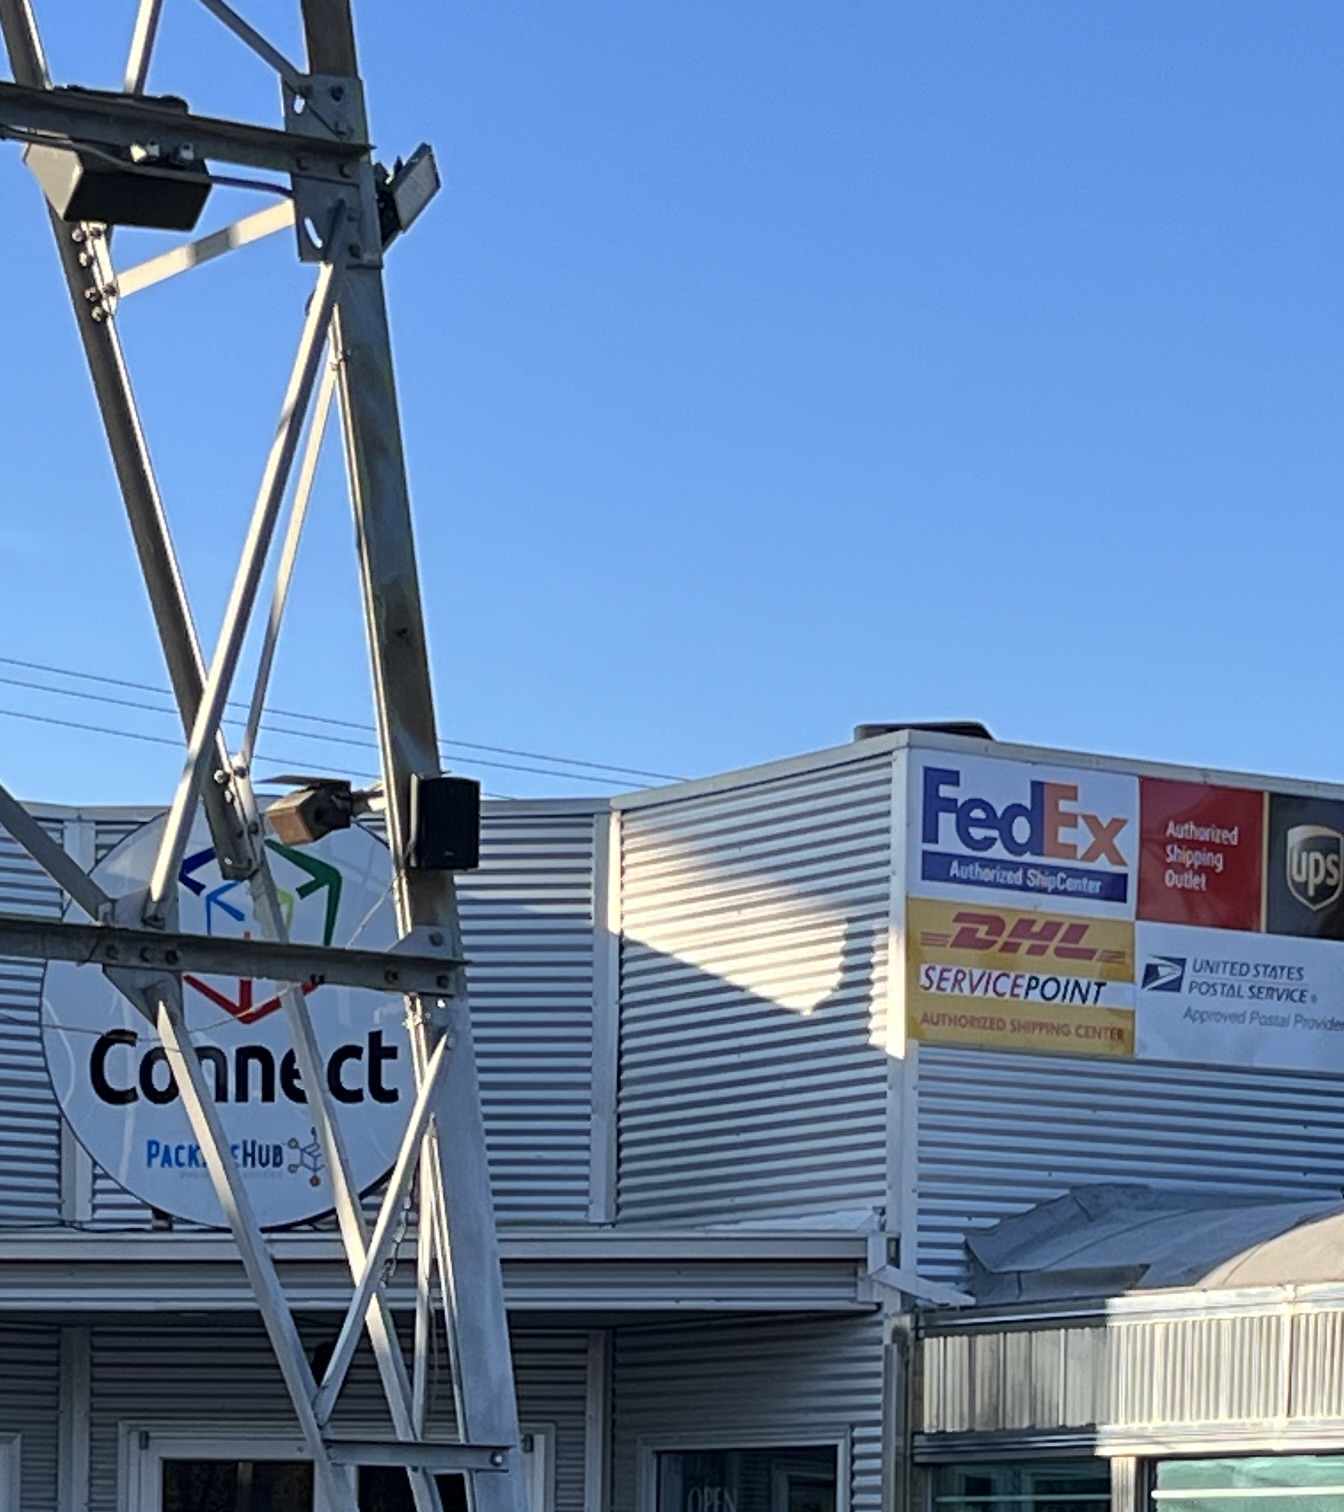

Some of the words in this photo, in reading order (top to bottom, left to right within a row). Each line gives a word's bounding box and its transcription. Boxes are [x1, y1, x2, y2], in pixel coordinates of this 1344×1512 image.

[922, 766, 1129, 867] FedEx
[1166, 821, 1238, 845] Authorized
[1166, 844, 1224, 873] Shipping
[1291, 849, 1340, 897] ups
[950, 860, 1022, 886] Authorized
[1027, 868, 1102, 893] ShipCenter
[1165, 869, 1207, 892] Outlet
[950, 911, 1098, 961] DHL
[1193, 958, 1250, 977] UNITED
[1253, 963, 1304, 981] STATES
[920, 965, 1107, 1005] SERVICEPOINT
[1188, 981, 1244, 999] POSTAL
[1248, 985, 1308, 1004] SERVICE
[920, 1011, 1006, 1031] AUTHORIZED
[1010, 1019, 1071, 1038] SHIPPING
[1075, 1025, 1125, 1041] CENTER
[1183, 1006, 1246, 1025] Approved
[1249, 1010, 1290, 1027] Postal
